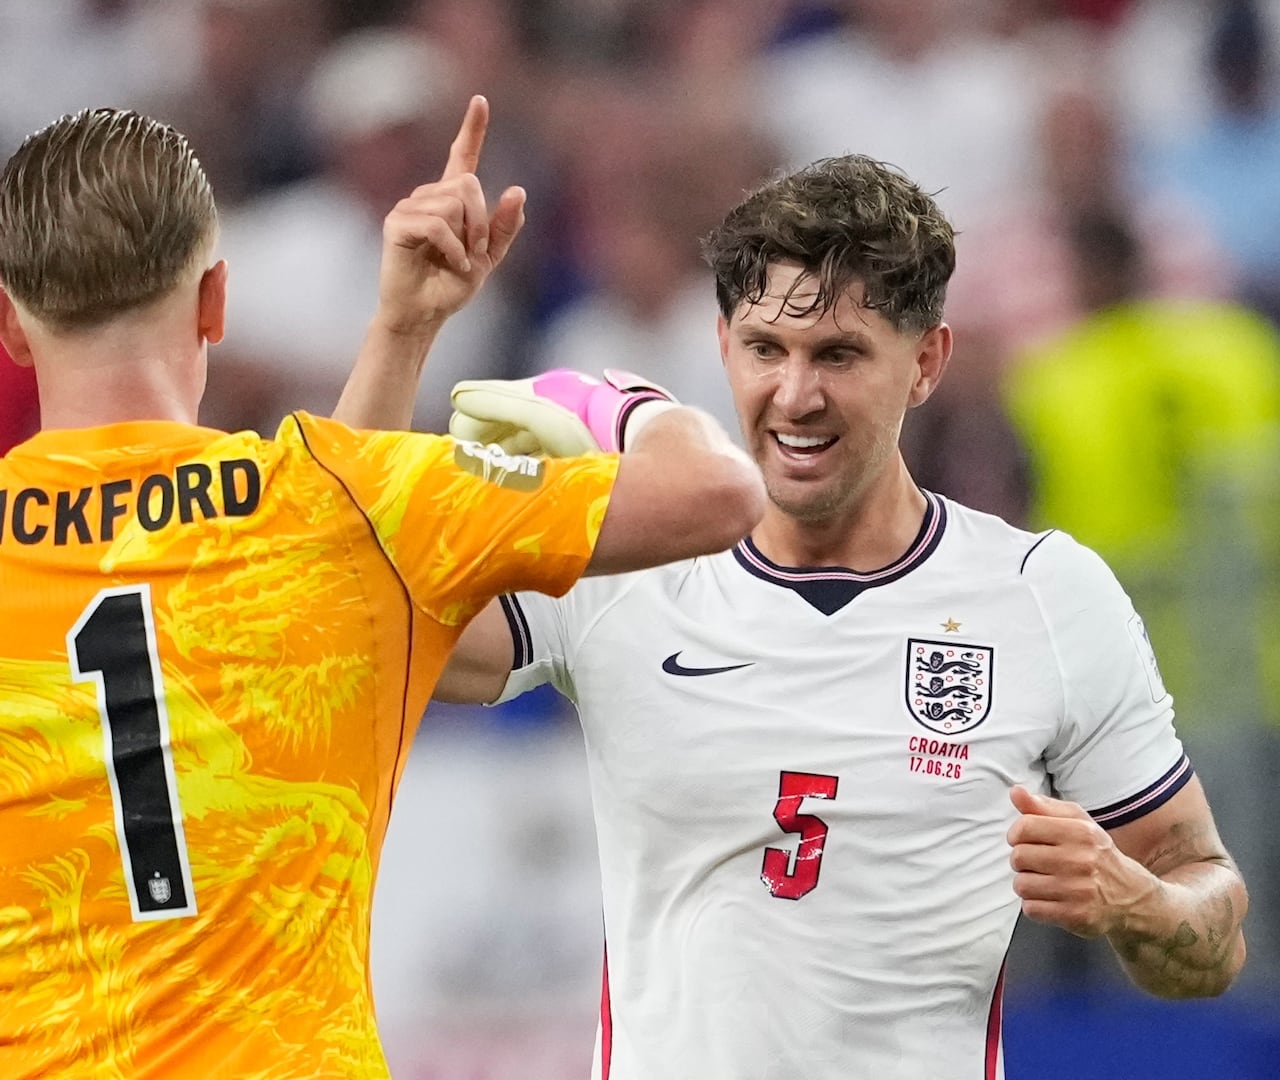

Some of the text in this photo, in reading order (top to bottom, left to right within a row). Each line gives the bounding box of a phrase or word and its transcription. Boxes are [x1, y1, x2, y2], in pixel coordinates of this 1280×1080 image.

[66, 583, 199, 922] 1
[908, 736, 969, 760] CROATIA
[909, 756, 962, 779] 17.06.26
[760, 770, 839, 901] 5
